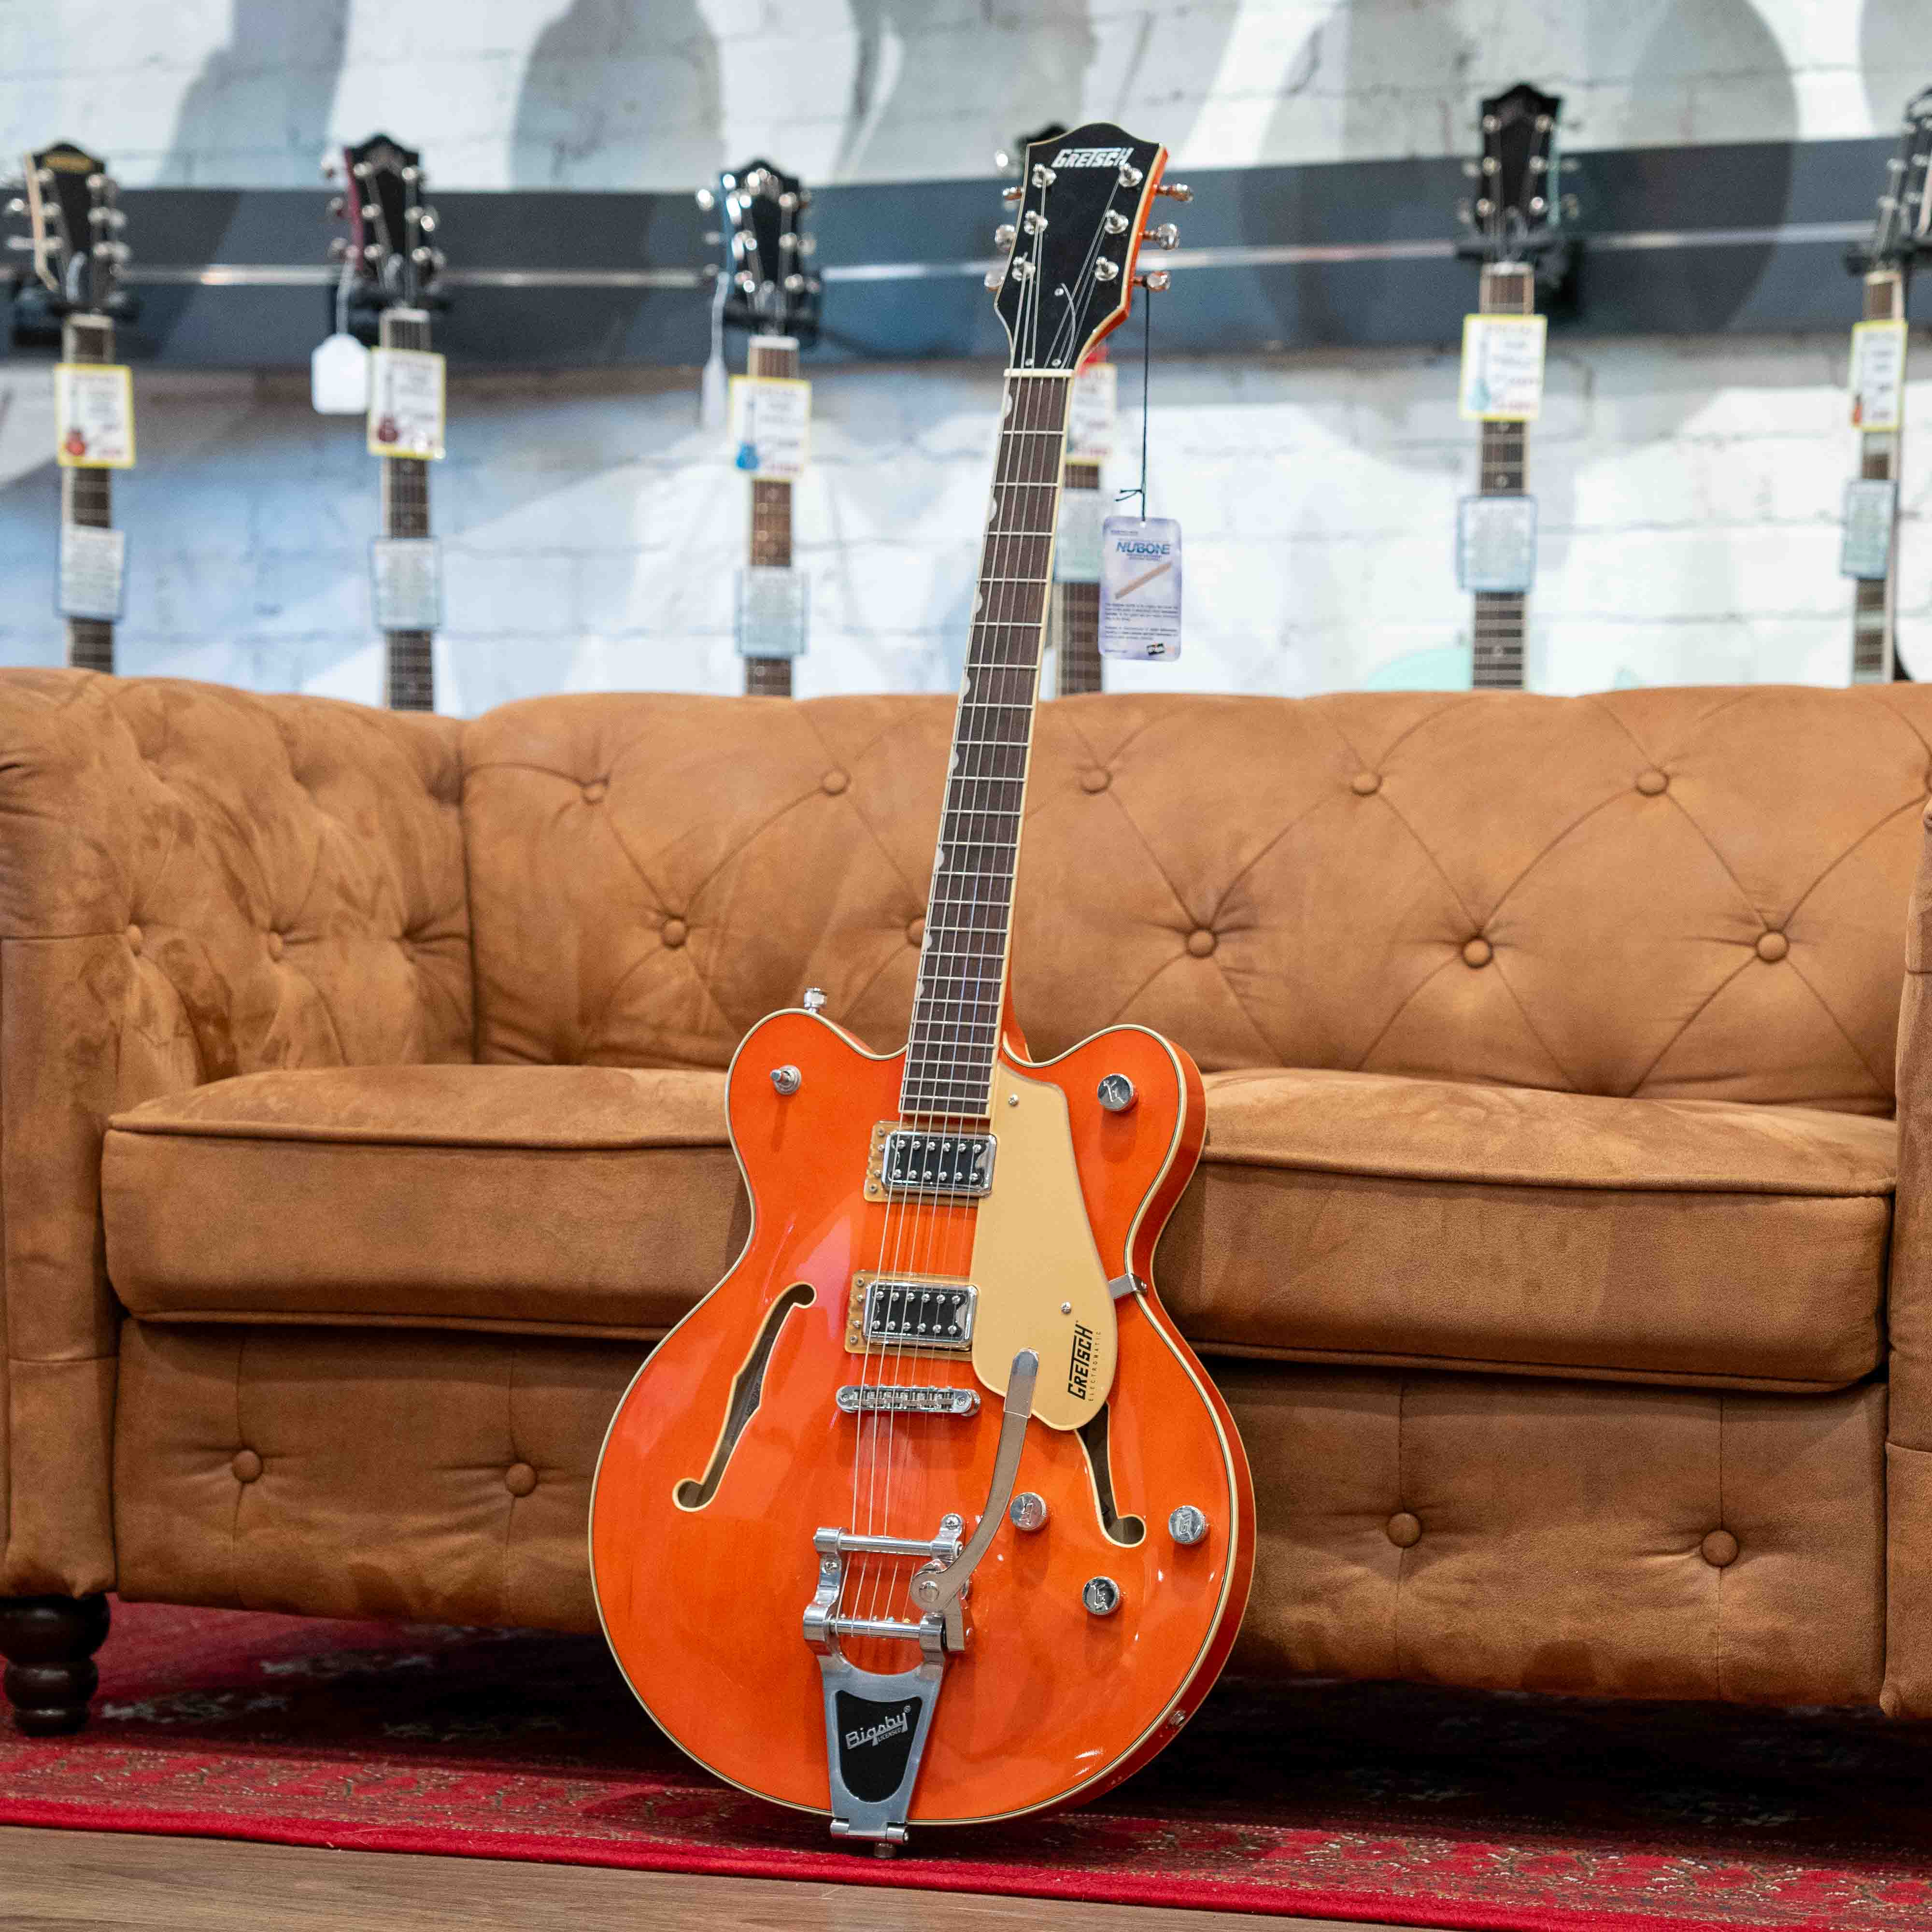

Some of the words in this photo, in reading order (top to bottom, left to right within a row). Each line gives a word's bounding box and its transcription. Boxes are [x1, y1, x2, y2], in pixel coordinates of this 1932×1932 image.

[1051, 147, 1134, 168] GRETSCH
[1117, 541, 1171, 555] NUBONE
[1067, 1323, 1094, 1400] GRETSCH
